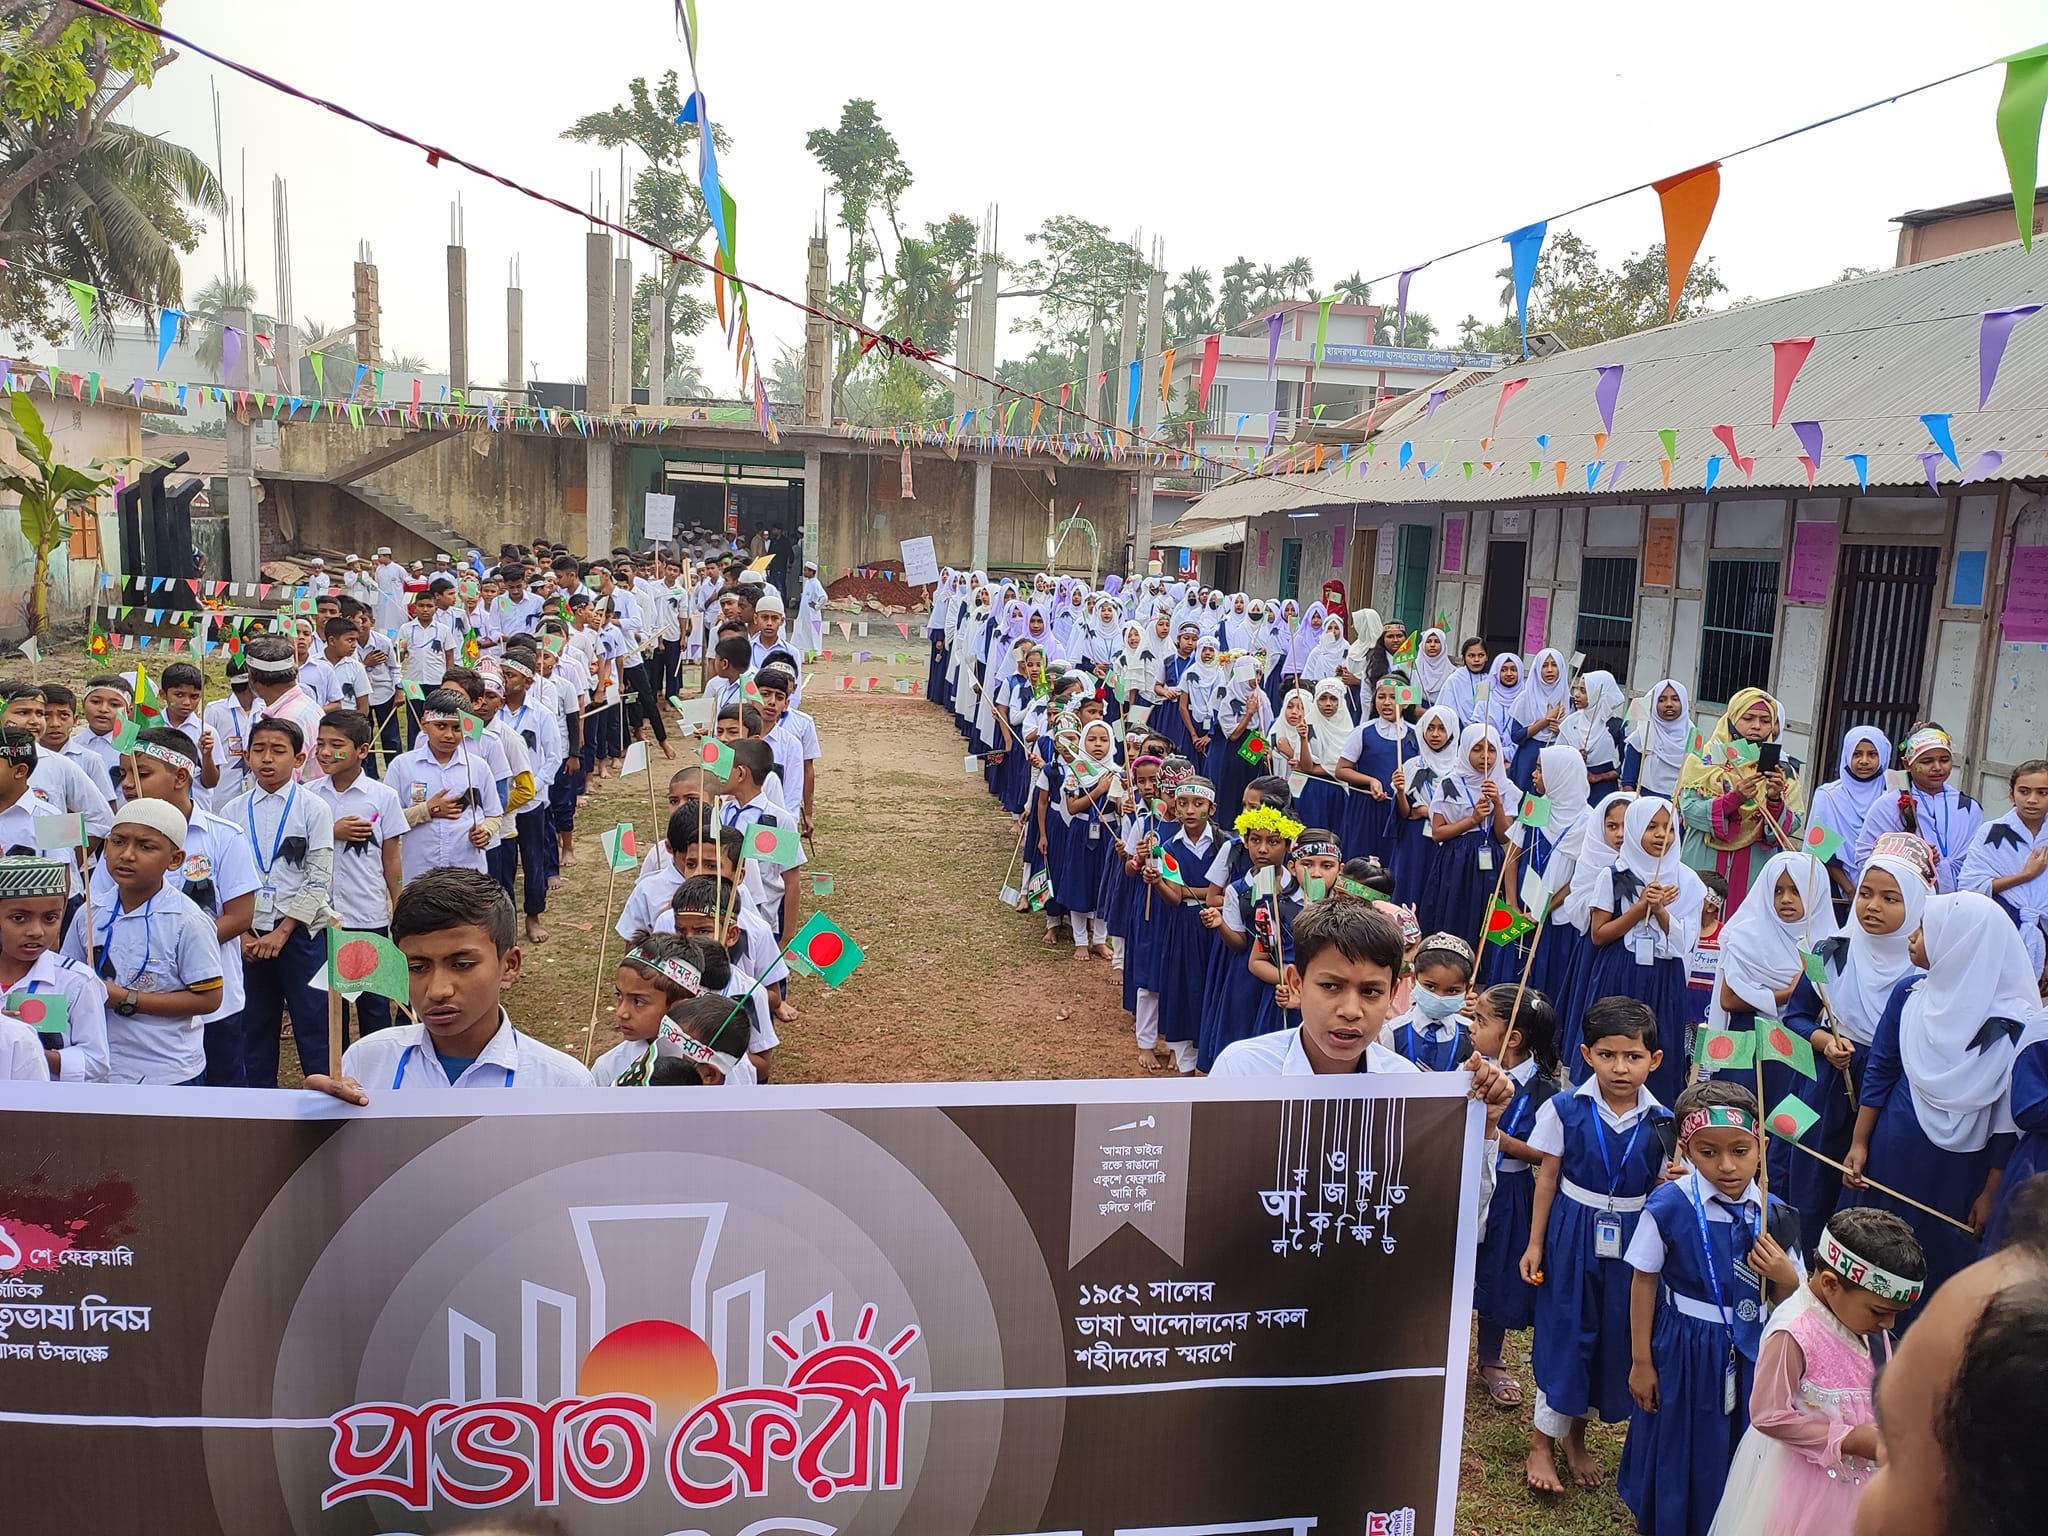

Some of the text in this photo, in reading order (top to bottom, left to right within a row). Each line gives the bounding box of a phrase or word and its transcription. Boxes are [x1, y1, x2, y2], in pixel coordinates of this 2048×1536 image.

[1134, 1143, 1164, 1156] ভাইরে
[1101, 1159, 1160, 1171] রক্তে রাঙানো
[1093, 1174, 1122, 1187] একুশে
[1110, 1185, 1149, 1198] আমি কি
[1098, 1200, 1131, 1217] ভুলিতে
[30, 1247, 51, 1265] শে
[58, 1245, 135, 1268] ফেব্রুয়ারি
[1828, 1239, 1869, 1286] অমর
[1078, 1279, 1216, 1307] ১৯৫২ সালের
[79, 1295, 153, 1333] দিবস
[1074, 1308, 1309, 1338] ভাষা আন্দোলনের সকল
[37, 1341, 110, 1364] উপলক্ষে
[1073, 1339, 1237, 1373] শহীদদের স্মরণে
[321, 1338, 916, 1511] প্রভাত ফেরী
